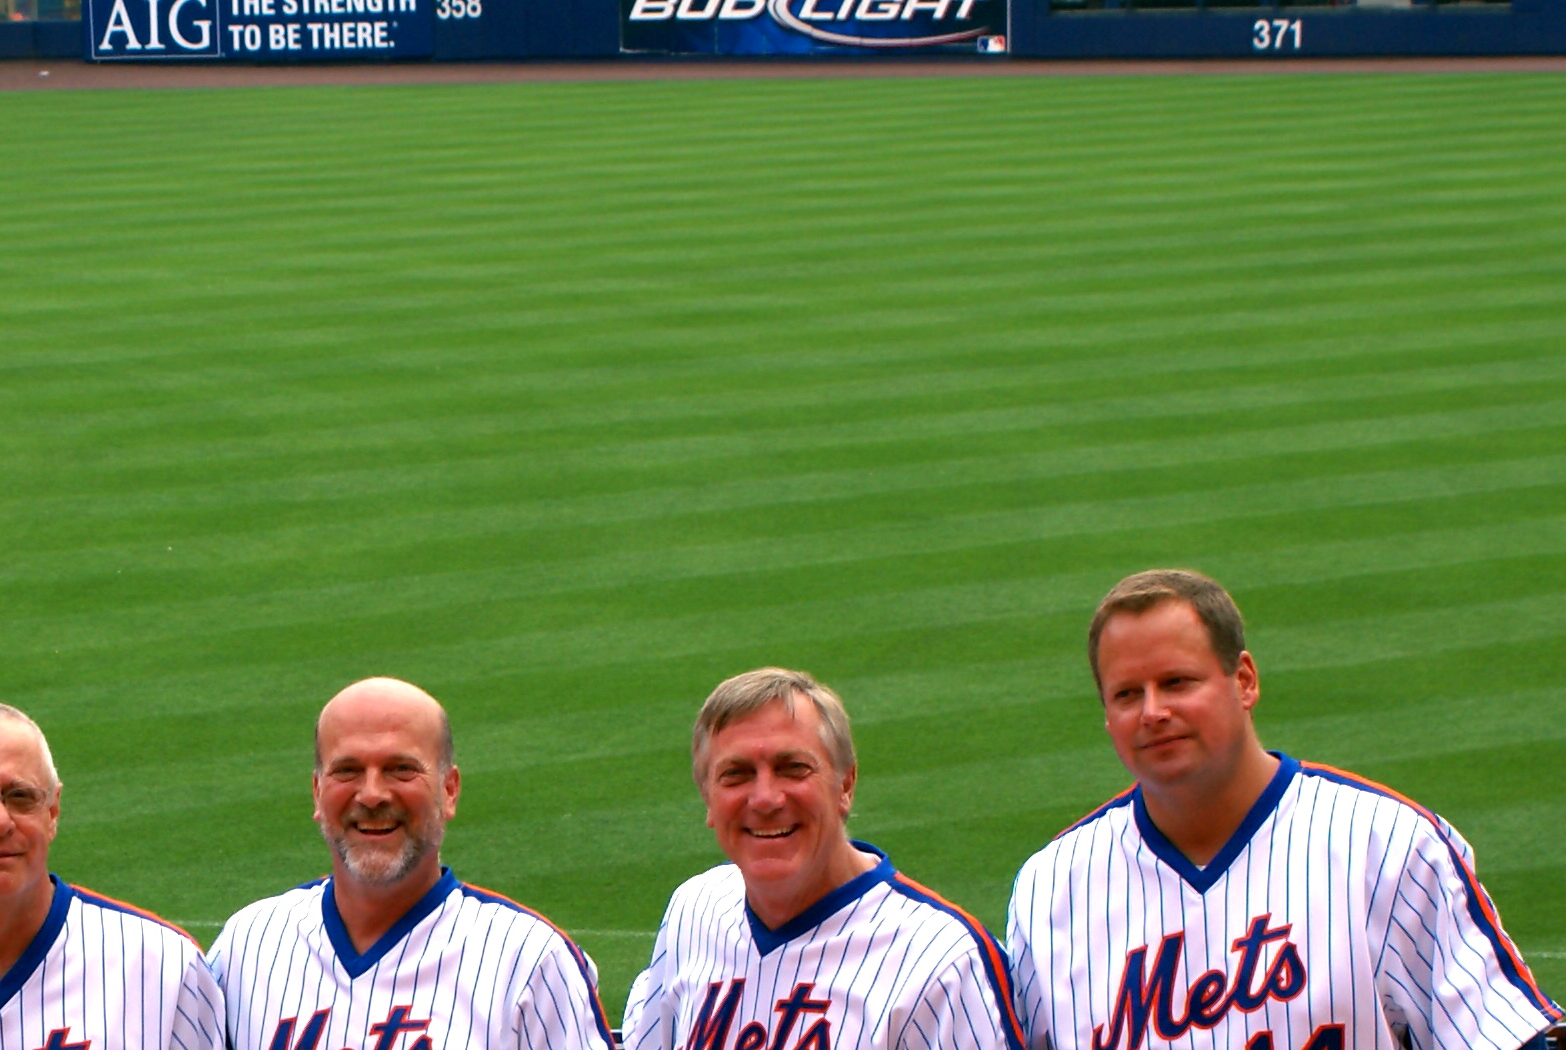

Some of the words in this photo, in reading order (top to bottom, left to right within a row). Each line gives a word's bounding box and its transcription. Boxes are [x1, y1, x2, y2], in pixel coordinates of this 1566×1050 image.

[99, 0, 212, 50] AIG
[436, 0, 482, 19] 358
[629, 0, 766, 20] BUD
[798, 0, 975, 20] LIGHT
[228, 23, 261, 51] TO
[269, 23, 301, 50] BE
[307, 20, 395, 49] THERE.
[1253, 18, 1302, 49] 371
